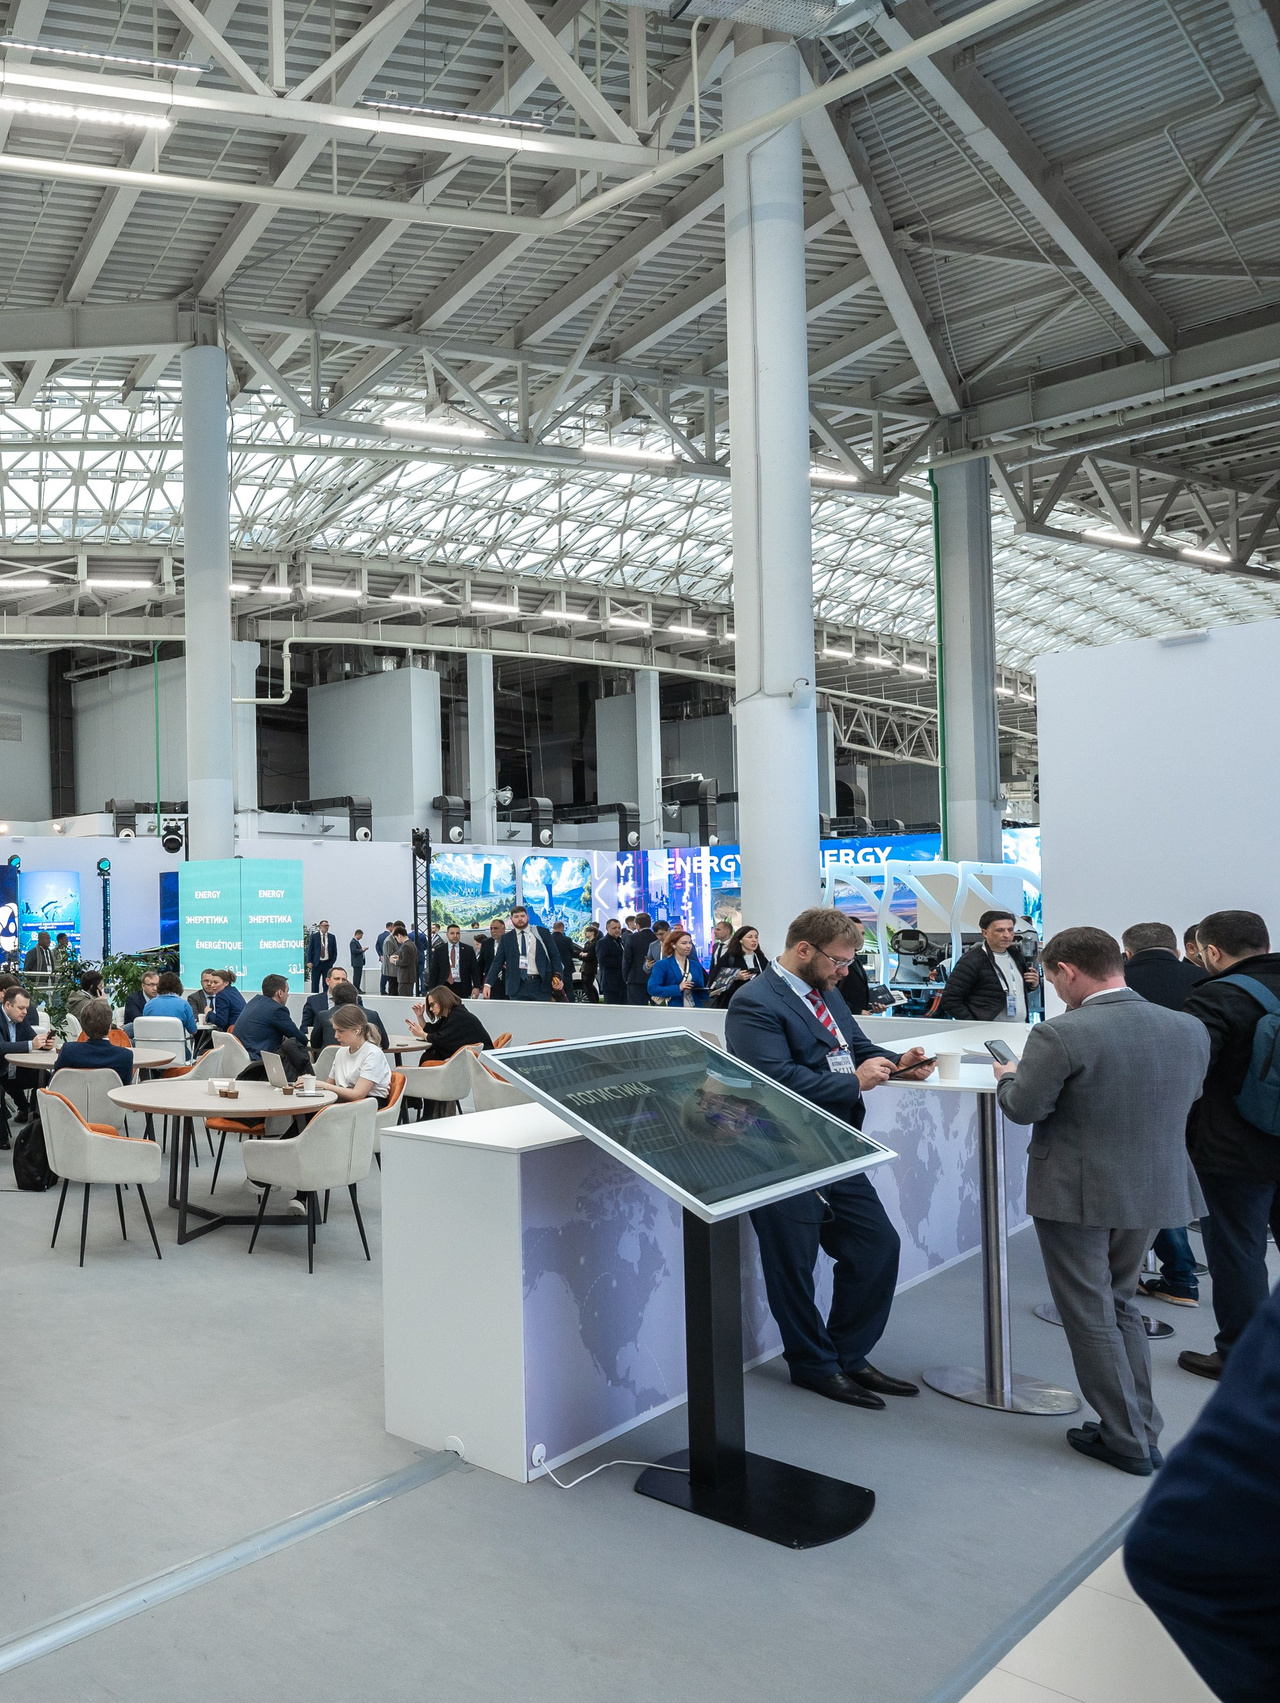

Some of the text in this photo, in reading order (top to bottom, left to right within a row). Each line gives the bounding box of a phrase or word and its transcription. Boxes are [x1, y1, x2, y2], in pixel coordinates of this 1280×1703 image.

[820, 846, 893, 867] ERGY
[194, 890, 221, 899] ENERGY
[258, 889, 285, 898] ENERGY
[185, 915, 229, 924] ЭНЕРГЕТИКА
[248, 915, 293, 924] ЭНЕРГЕТИКА
[195, 939, 243, 950] ÉNERGÉTIQUE
[259, 938, 304, 949] ÉNERGÉTIQUE
[566, 1081, 657, 1107] ЛОГИСТИКА
